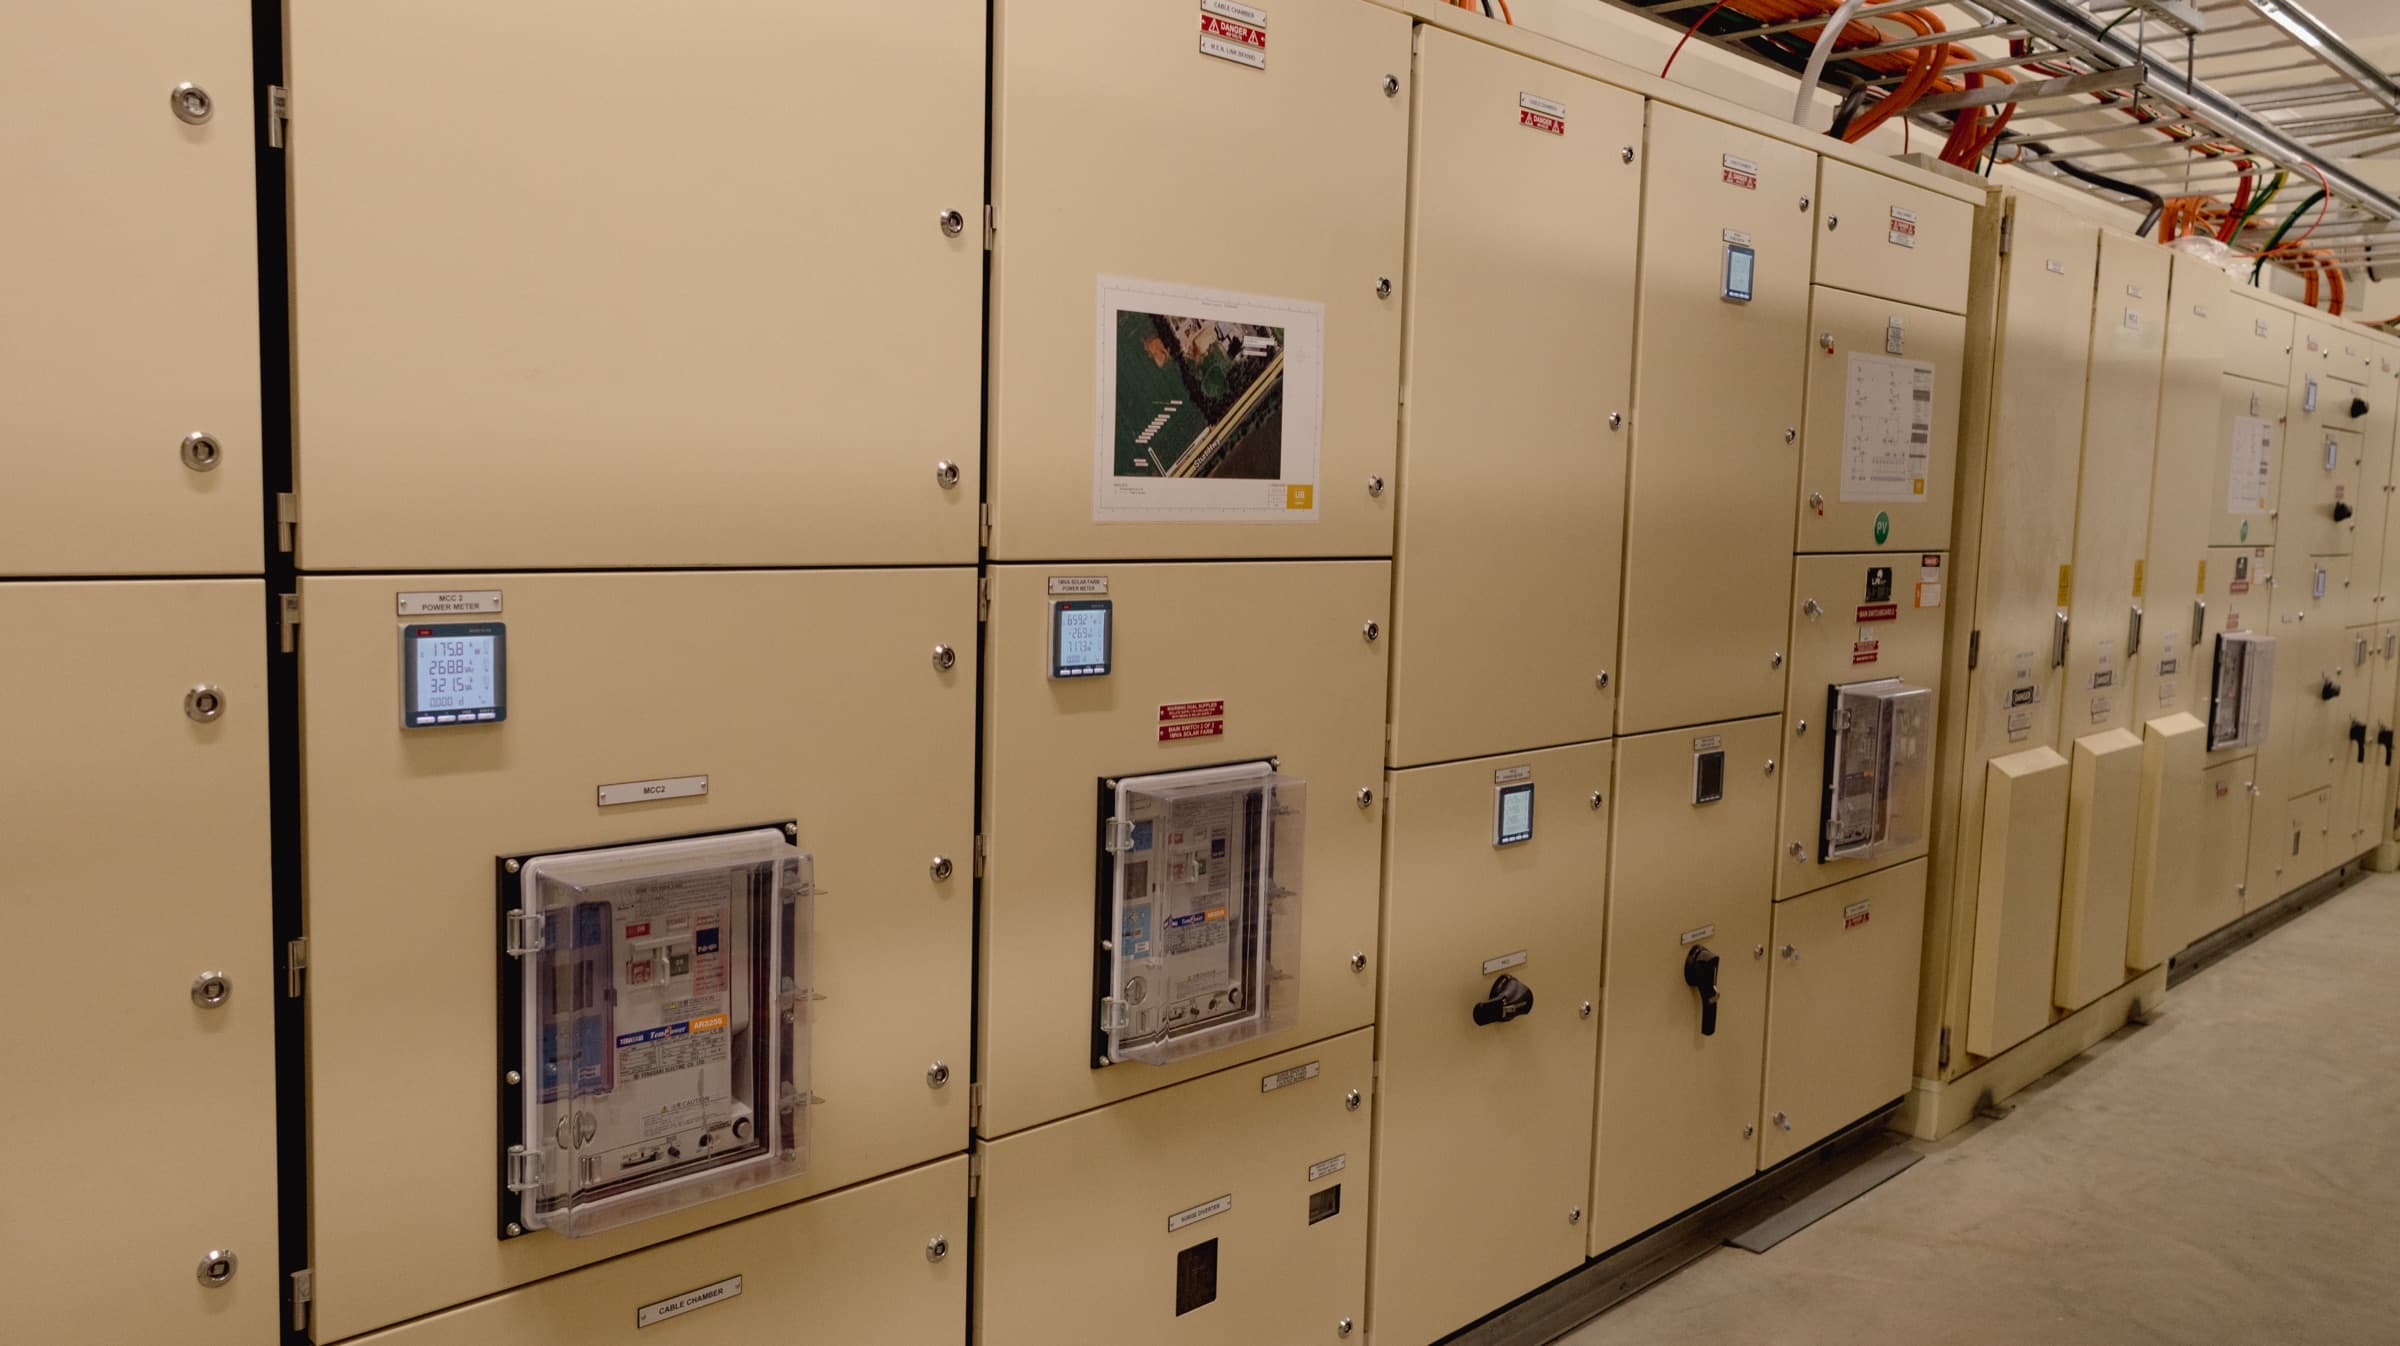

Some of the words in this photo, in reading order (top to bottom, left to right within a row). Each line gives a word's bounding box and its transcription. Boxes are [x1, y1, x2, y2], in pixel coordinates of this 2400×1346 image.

[1220, 22, 1248, 36] DANGER
[1876, 521, 1888, 535] PV
[434, 641, 464, 656] 175.8
[429, 660, 464, 675] 268.8
[431, 677, 464, 693] 321.5
[643, 786, 666, 794] MCC2
[658, 1301, 685, 1315] CABLE
[686, 1288, 724, 1306] CHAMBER
